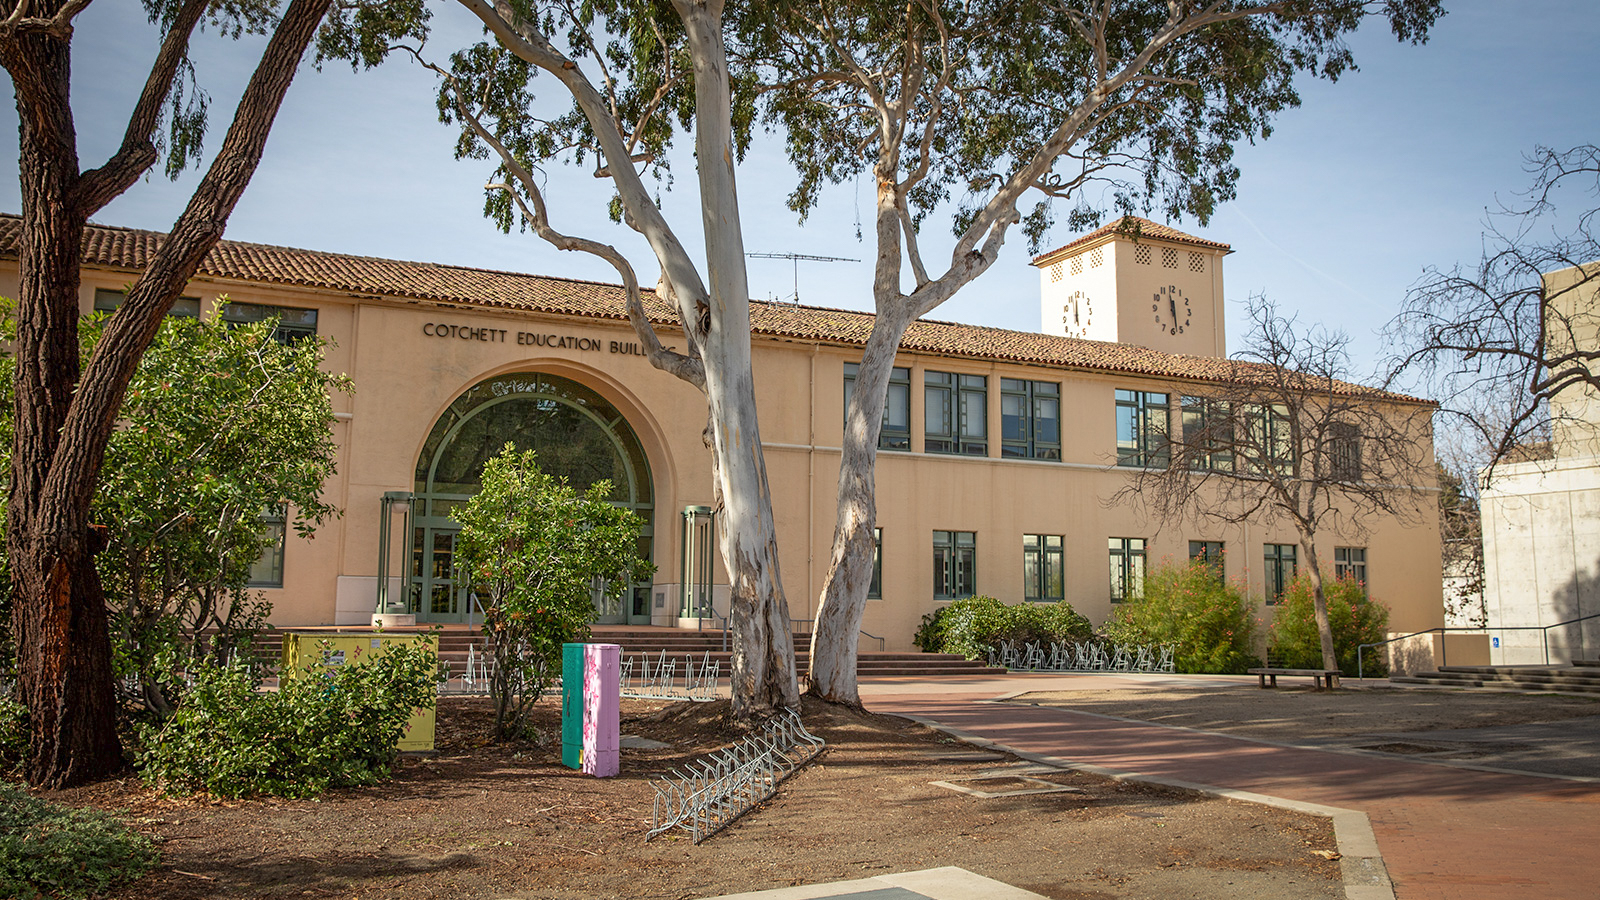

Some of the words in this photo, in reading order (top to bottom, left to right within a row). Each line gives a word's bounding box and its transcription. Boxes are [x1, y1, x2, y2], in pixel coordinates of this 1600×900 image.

[1160, 286, 1166, 294] 11
[1169, 285, 1176, 294] 12
[1154, 294, 1160, 302] 10
[1184, 298, 1189, 306] 2
[1152, 304, 1158, 312] 9
[1187, 308, 1192, 316] 3
[1155, 315, 1159, 323] 8
[1162, 324, 1166, 332] 7
[1179, 326, 1184, 334] 5
[423, 322, 508, 342] COTCHETT
[517, 332, 600, 351] EDUCATION
